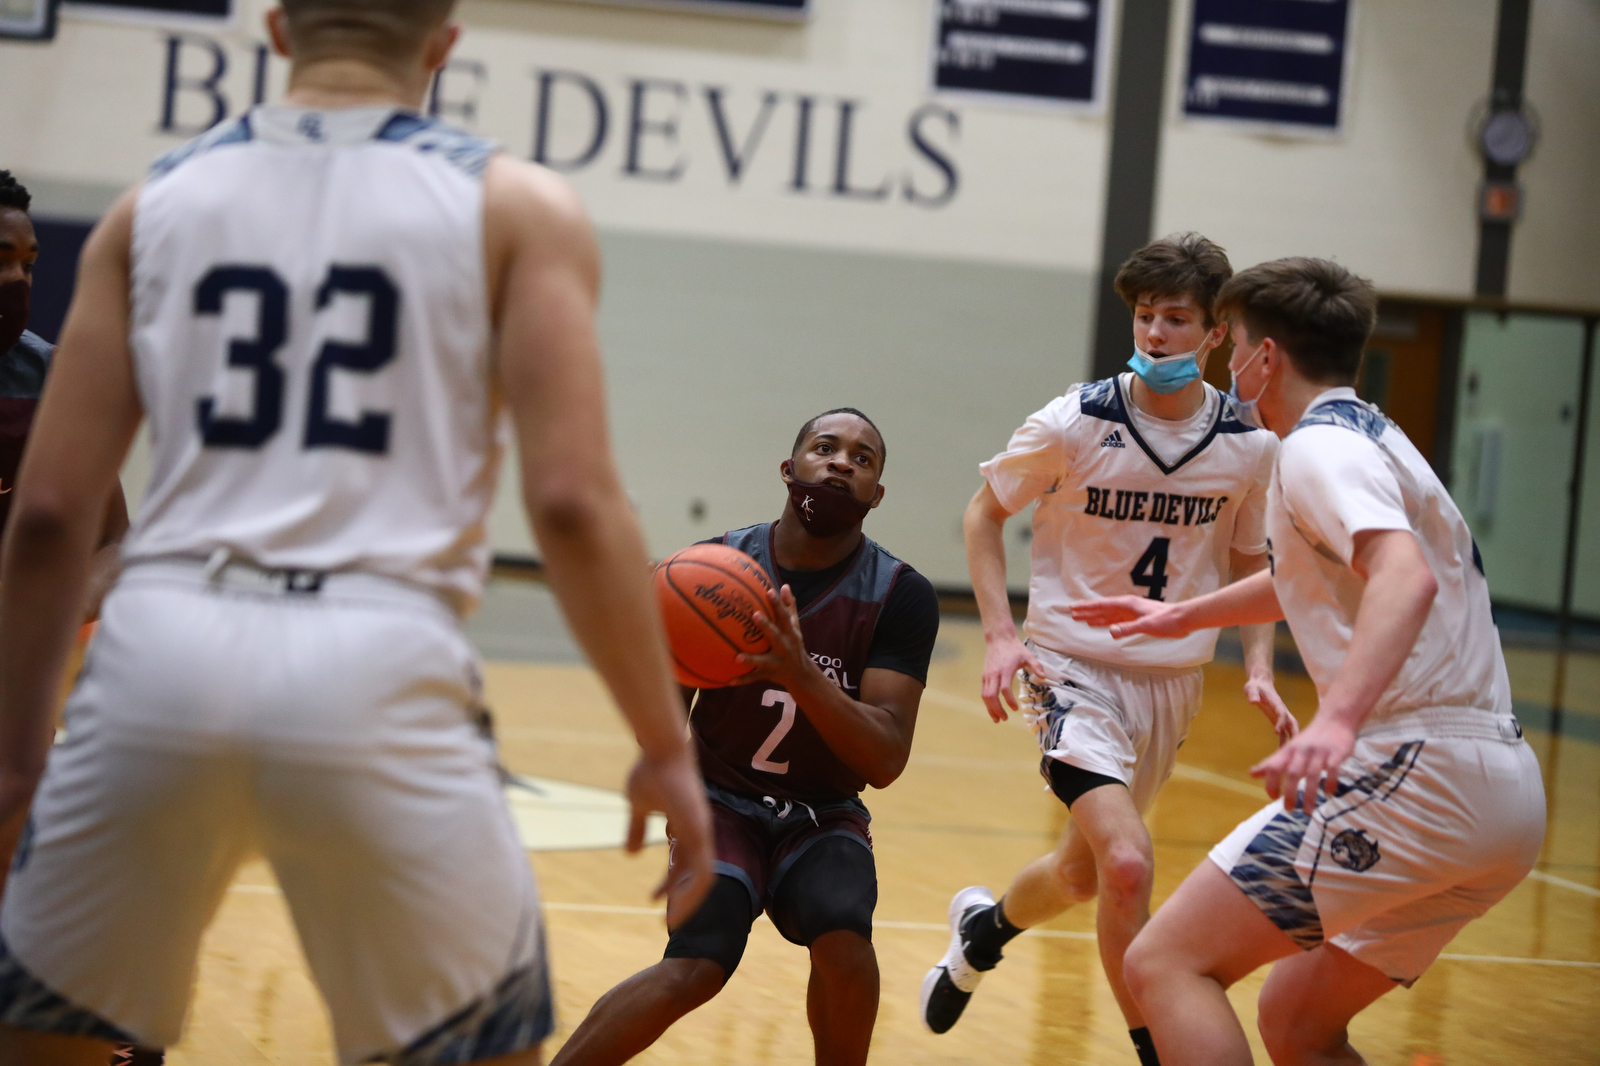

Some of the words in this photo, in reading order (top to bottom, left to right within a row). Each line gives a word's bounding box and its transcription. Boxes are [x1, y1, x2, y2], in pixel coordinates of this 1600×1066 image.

[155, 36, 487, 137] BLE
[532, 67, 961, 208] DEVILS
[193, 264, 402, 454] 32
[1100, 440, 1126, 449] adidas
[1084, 486, 1149, 521] BLUE
[1149, 492, 1229, 526] DEVILS
[1130, 536, 1171, 601] 4
[695, 582, 764, 645] Rawlings
[751, 689, 796, 775] 2
